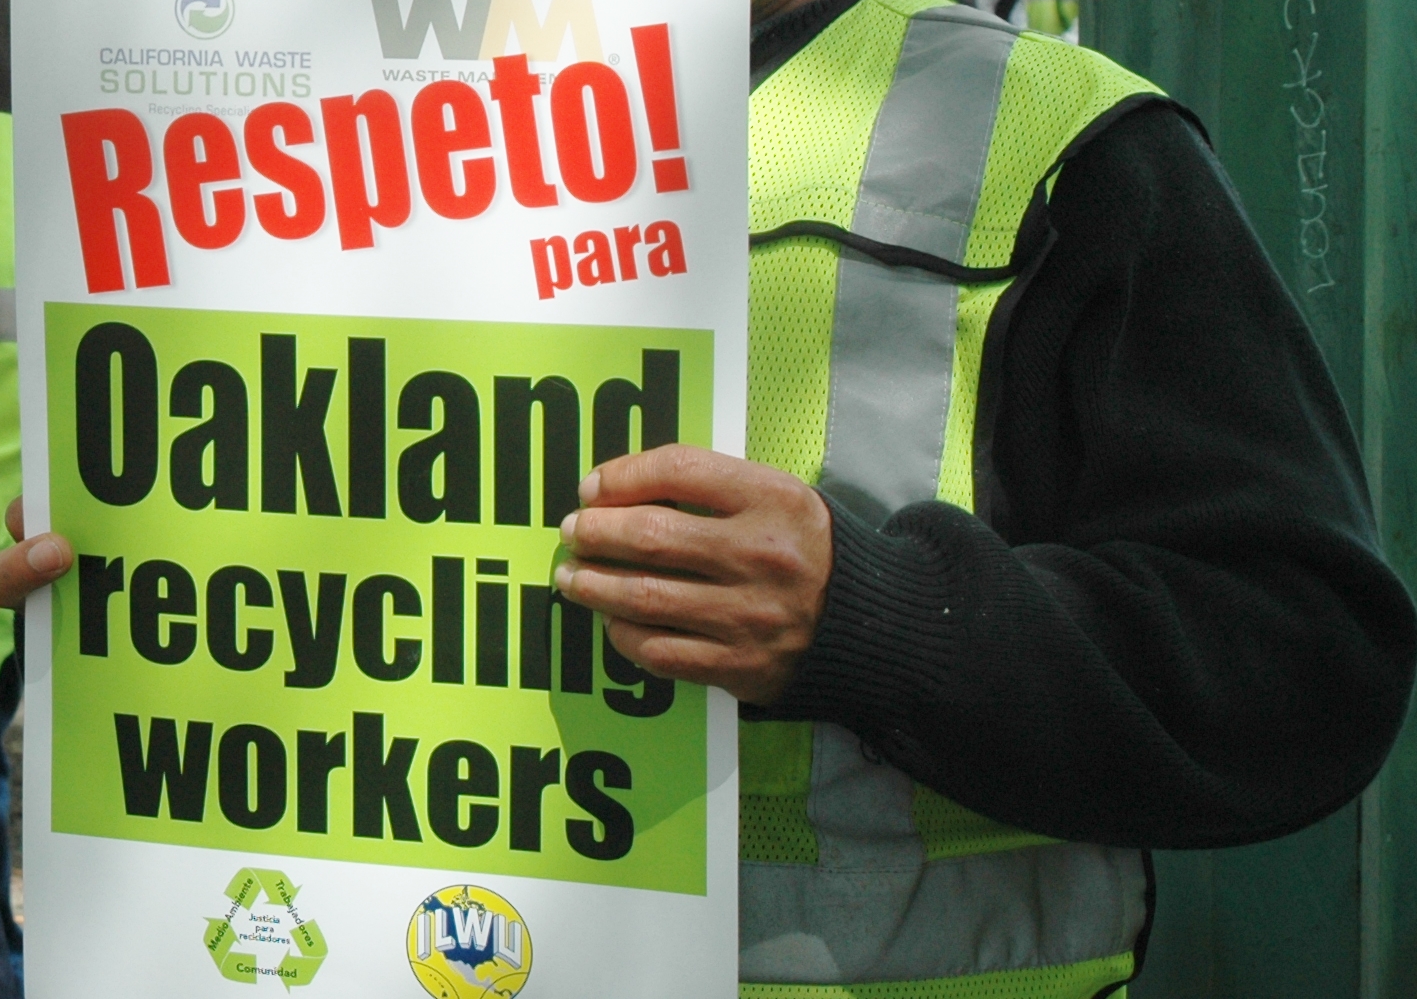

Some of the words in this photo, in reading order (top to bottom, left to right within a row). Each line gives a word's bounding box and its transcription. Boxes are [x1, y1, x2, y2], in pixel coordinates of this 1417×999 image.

[99, 48, 224, 67] CALIFORNIA
[236, 50, 312, 69] WASTE
[99, 68, 313, 98] SOLUTIONS
[382, 69, 451, 83] WASTE
[60, 22, 690, 295] Respeto!
[529, 219, 688, 300] para
[113, 710, 635, 860] workers
[207, 920, 229, 952] Medio
[225, 877, 255, 923] Ambiente
[248, 912, 281, 925] Justicia
[275, 879, 315, 948] Trabajadores
[239, 932, 291, 945] recicladores
[255, 924, 275, 936] para
[417, 907, 523, 970] ILWU
[236, 962, 298, 979] Comunidad
